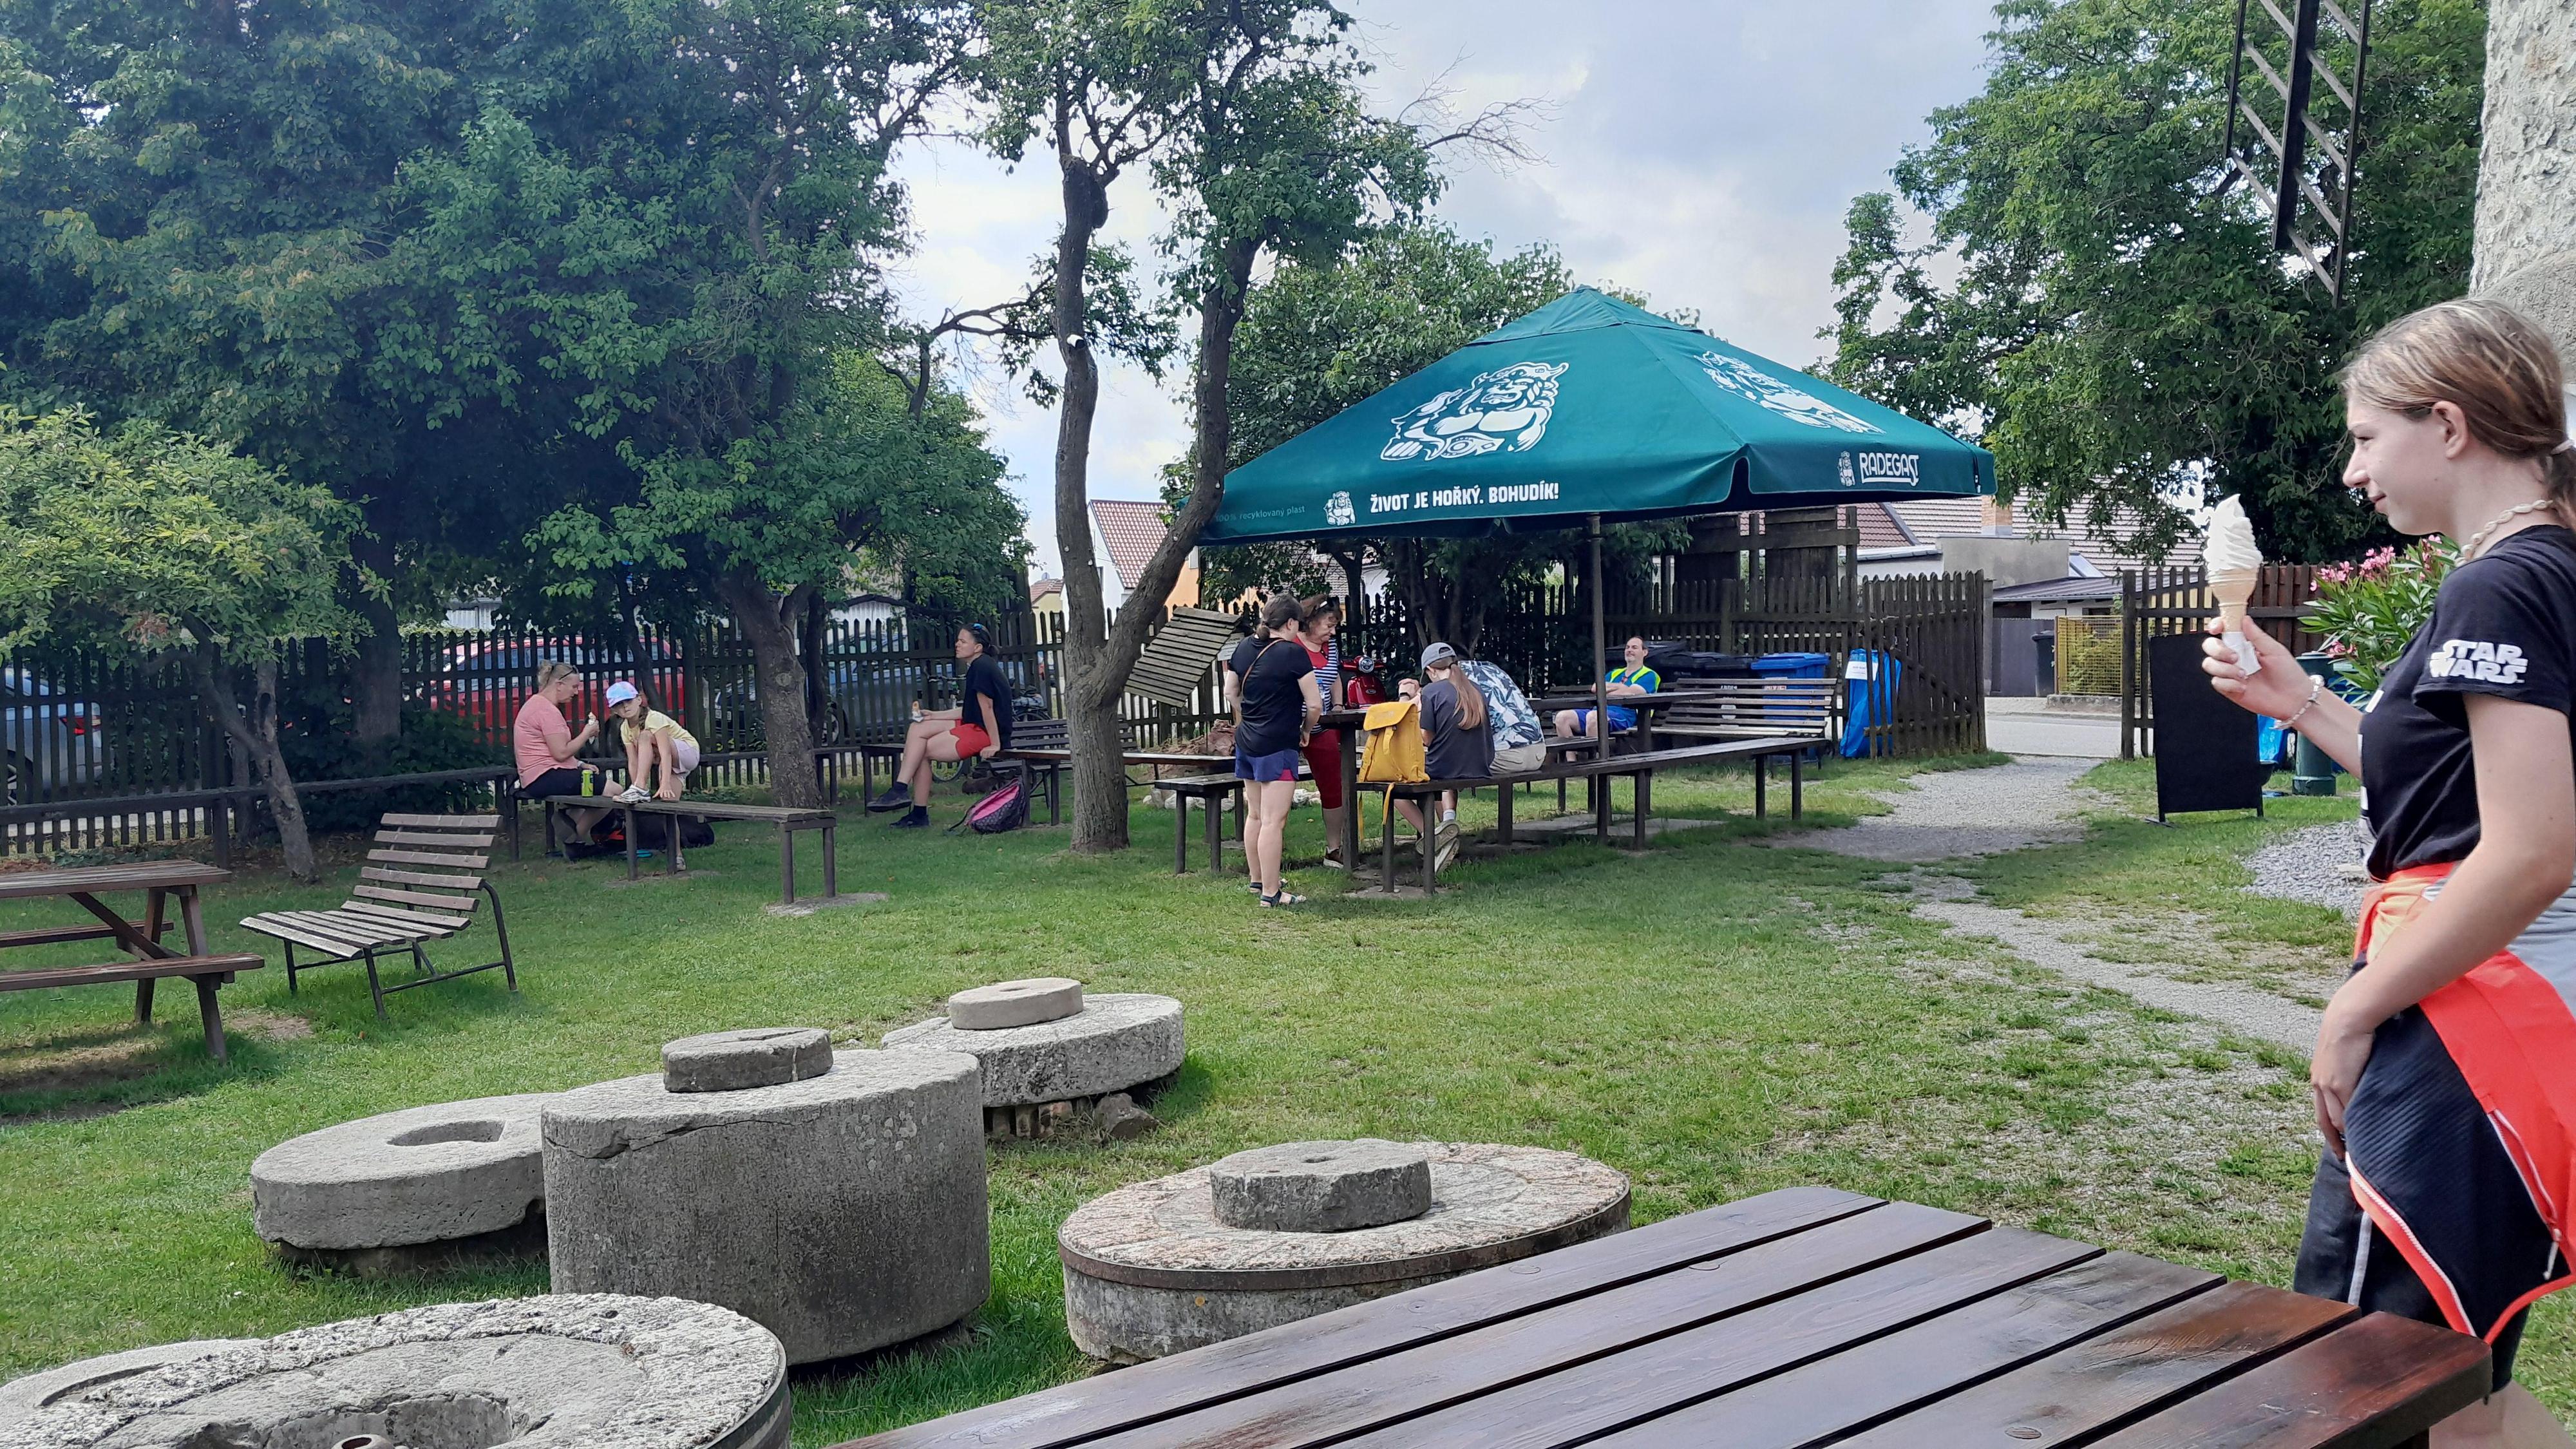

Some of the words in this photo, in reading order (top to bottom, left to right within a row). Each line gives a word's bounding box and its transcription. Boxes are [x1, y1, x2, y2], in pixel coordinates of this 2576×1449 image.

[1859, 452, 1919, 486] RADEGAST
[1370, 494, 1410, 513] ŽIVOT
[1414, 492, 1428, 509] JE
[1432, 484, 1484, 507] HOŘKÝ.
[1489, 480, 1559, 504] BOHUDÍK!
[1240, 507, 1285, 520] recyklovaný
[1287, 506, 1305, 515] plast
[2430, 639, 2528, 667] STAR
[2429, 658, 2527, 684] WARS
